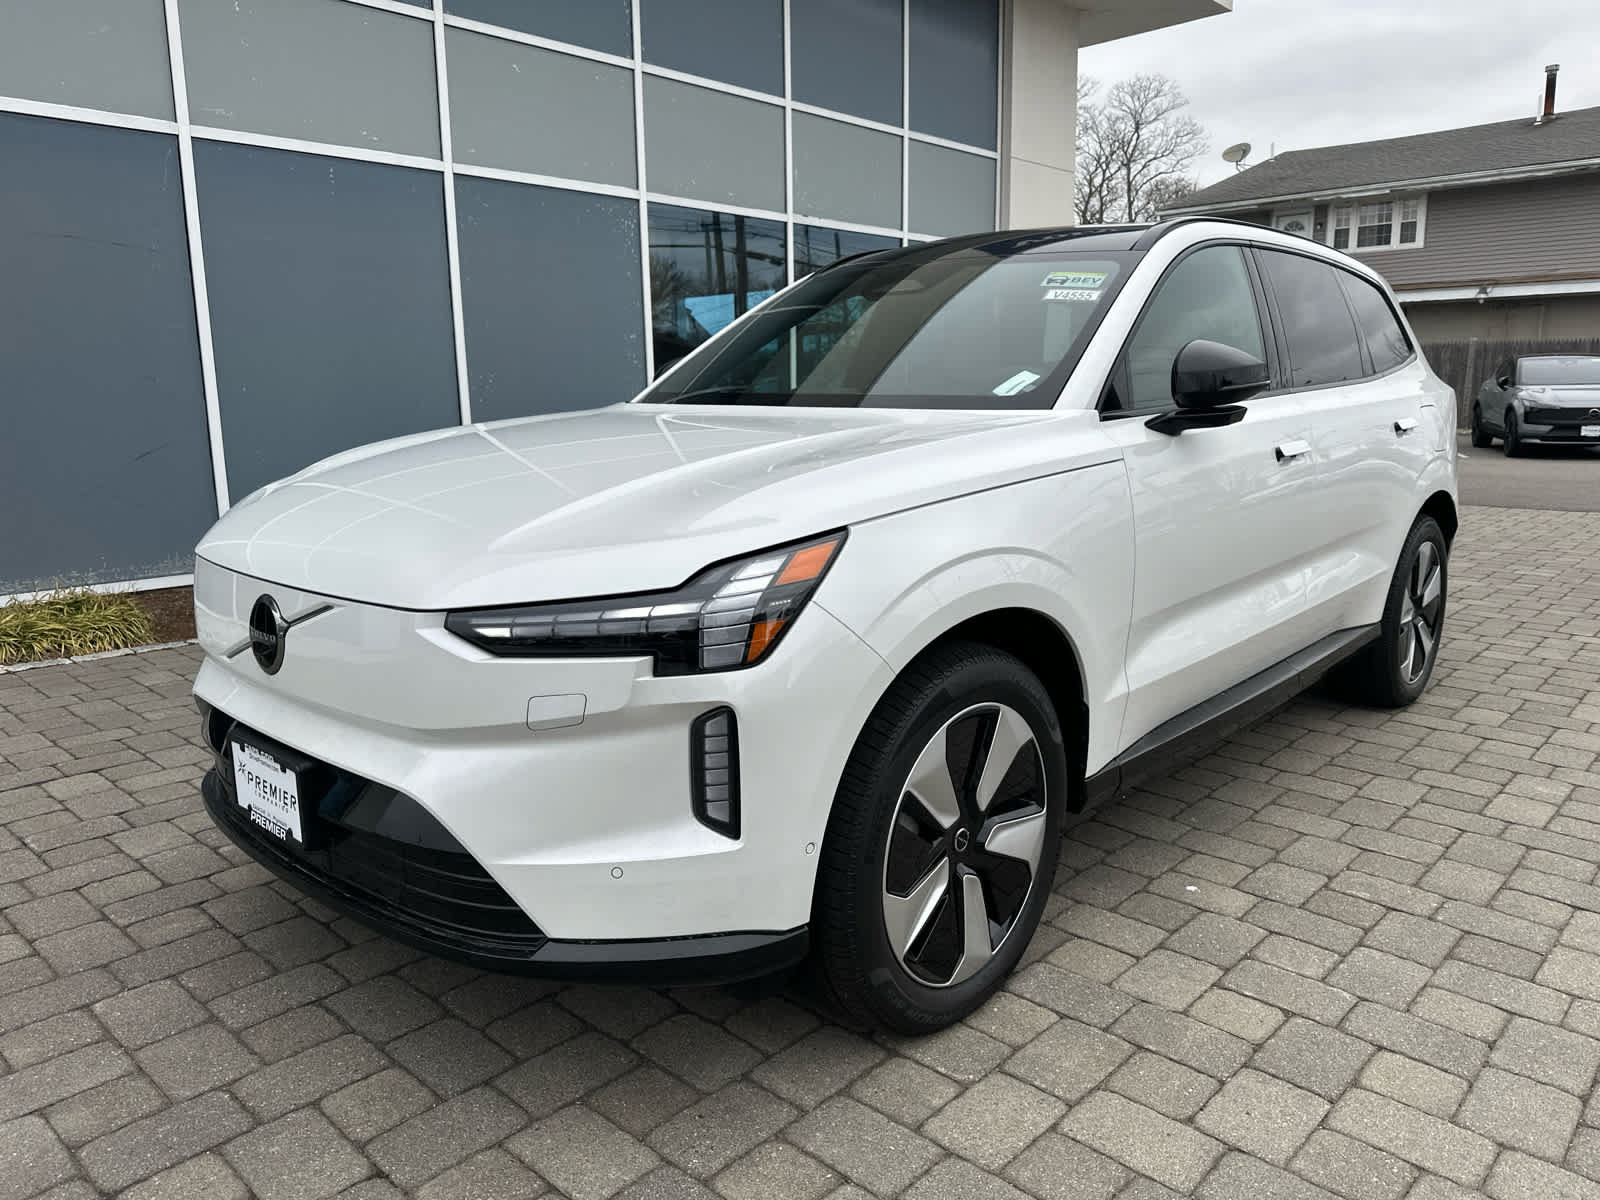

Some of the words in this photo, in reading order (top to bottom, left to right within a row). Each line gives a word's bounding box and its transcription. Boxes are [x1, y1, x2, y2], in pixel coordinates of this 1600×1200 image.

[1071, 276, 1102, 284] BEV
[1054, 291, 1095, 300] V4555
[247, 771, 297, 811] PREMIER
[250, 810, 286, 841] PREMIER
